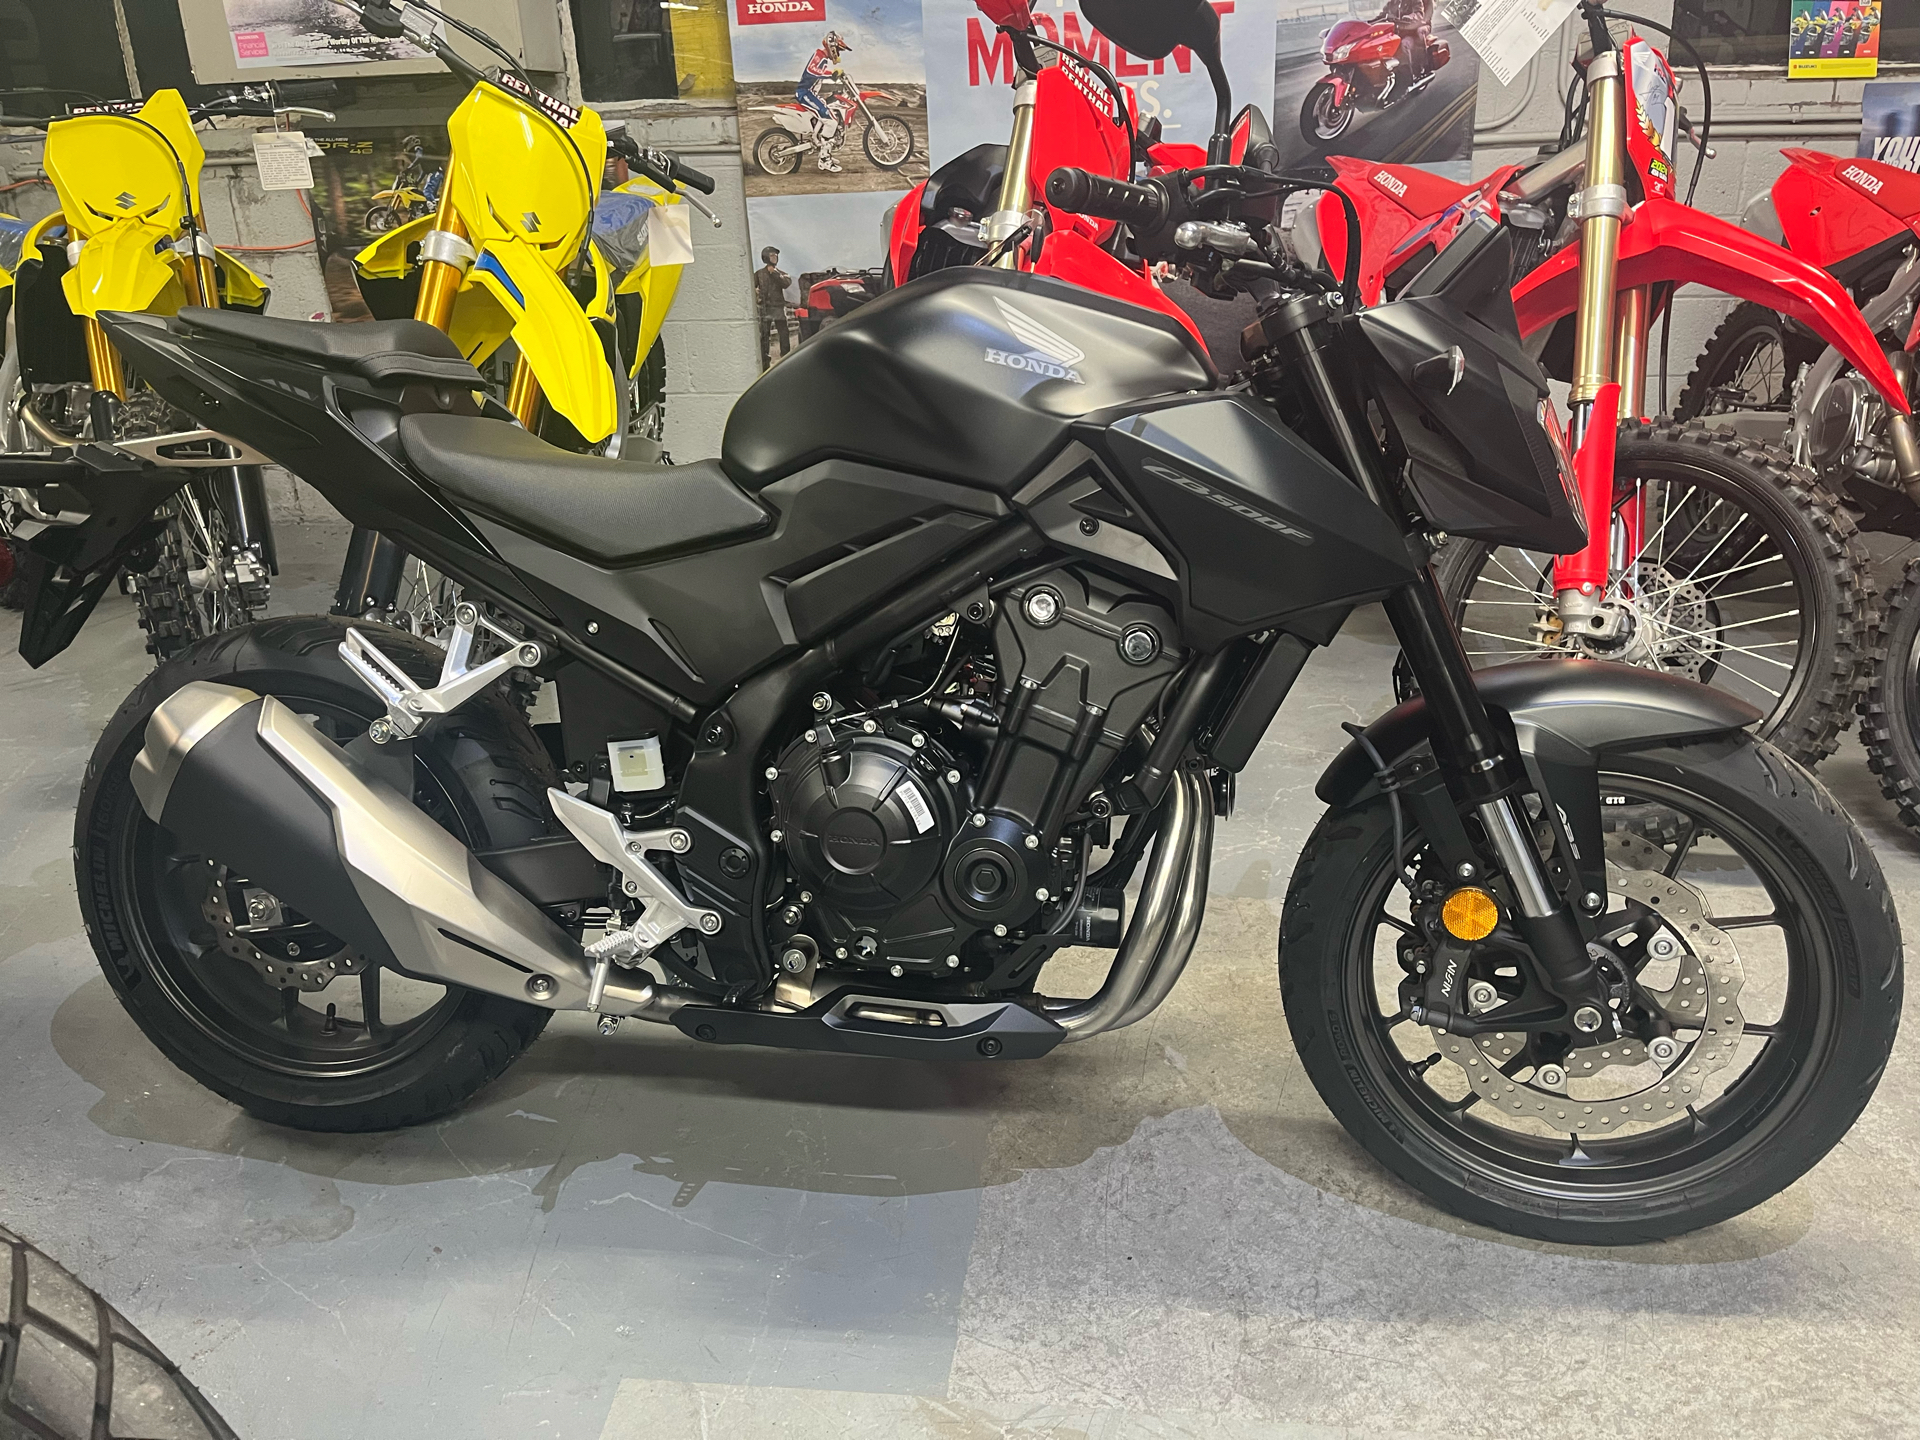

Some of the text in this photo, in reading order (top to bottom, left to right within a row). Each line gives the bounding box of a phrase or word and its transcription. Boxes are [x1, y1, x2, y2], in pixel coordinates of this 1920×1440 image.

[746, 1, 815, 15] HONDA
[1061, 52, 1111, 105] RENTHAL
[1061, 65, 1110, 118] RENTHAL
[1373, 169, 1409, 198] HONDA
[1841, 165, 1885, 195] HONDA
[984, 347, 1086, 385] HONDA
[1142, 465, 1313, 540] CB500F
[828, 835, 880, 847] HONDA
[1555, 802, 1581, 861] ABS
[90, 841, 125, 951] MICHELIN
[1440, 958, 1458, 998] NISSIN
[1331, 1025, 1349, 1058] ROAD
[1347, 1068, 1389, 1124] MICHELIN
